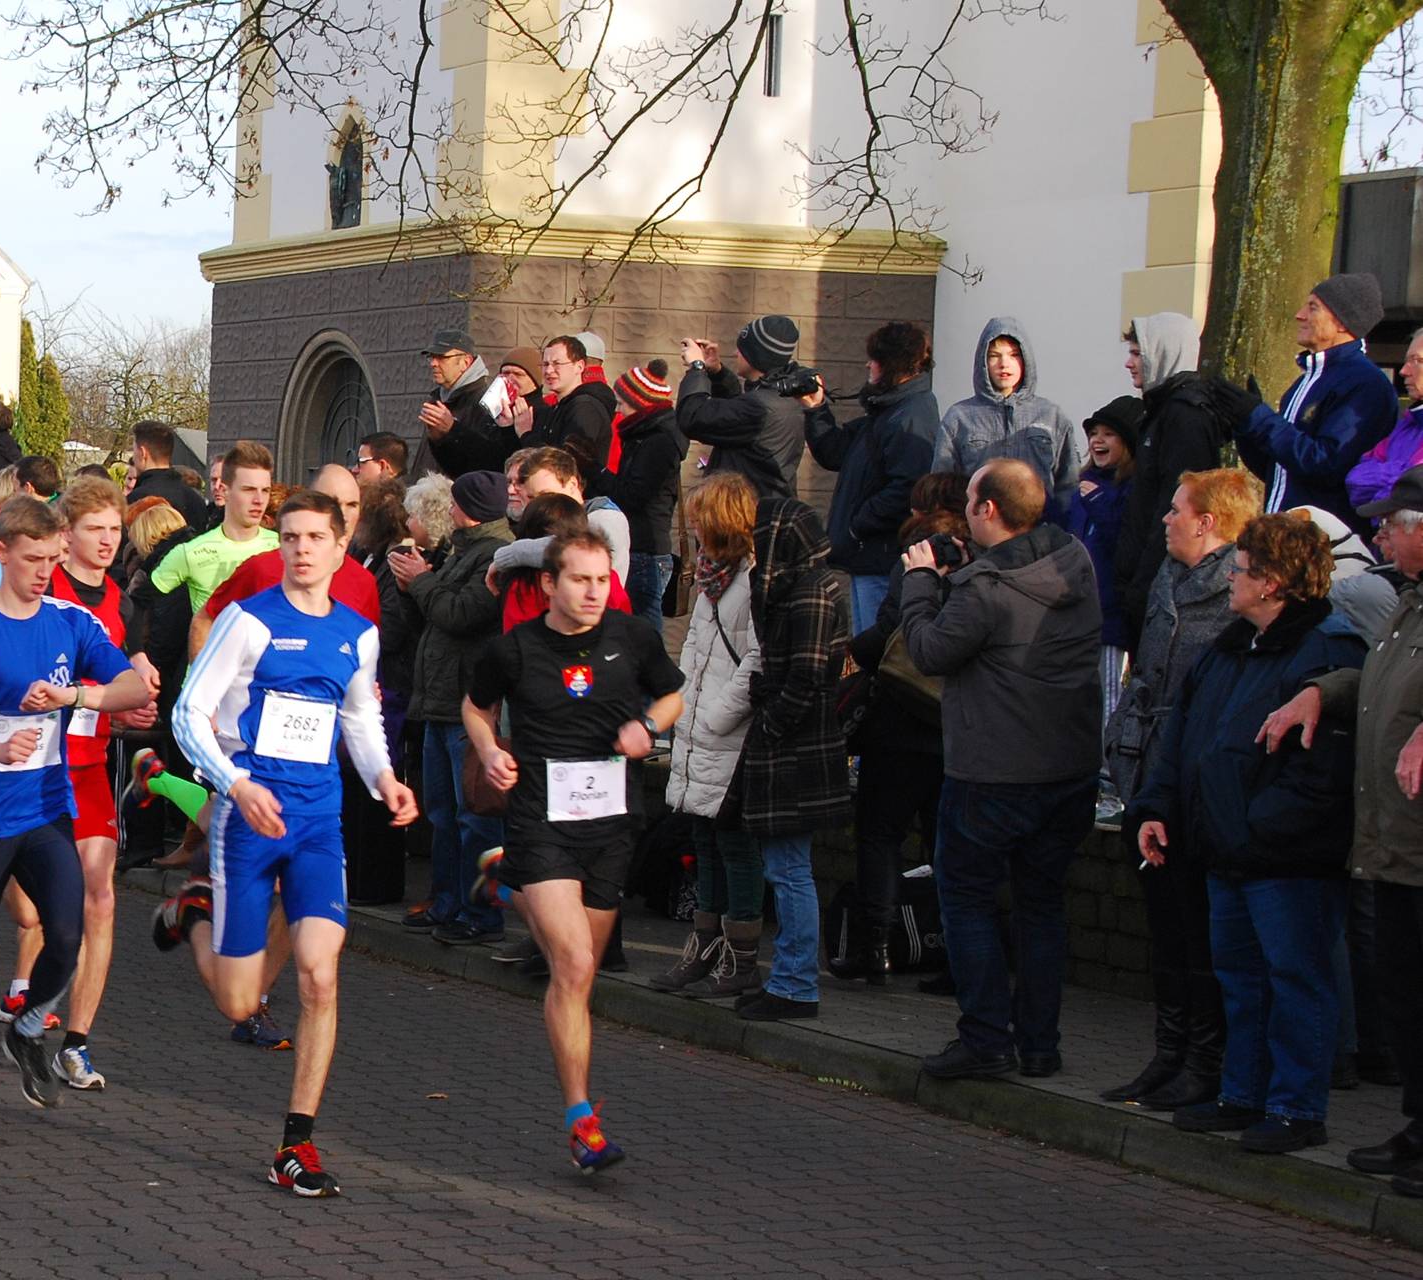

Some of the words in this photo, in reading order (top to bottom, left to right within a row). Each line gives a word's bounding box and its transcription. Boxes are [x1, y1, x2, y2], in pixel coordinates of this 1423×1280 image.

[283, 714, 321, 732] 2682
[585, 776, 596, 790] 2
[569, 791, 607, 801] Florian
